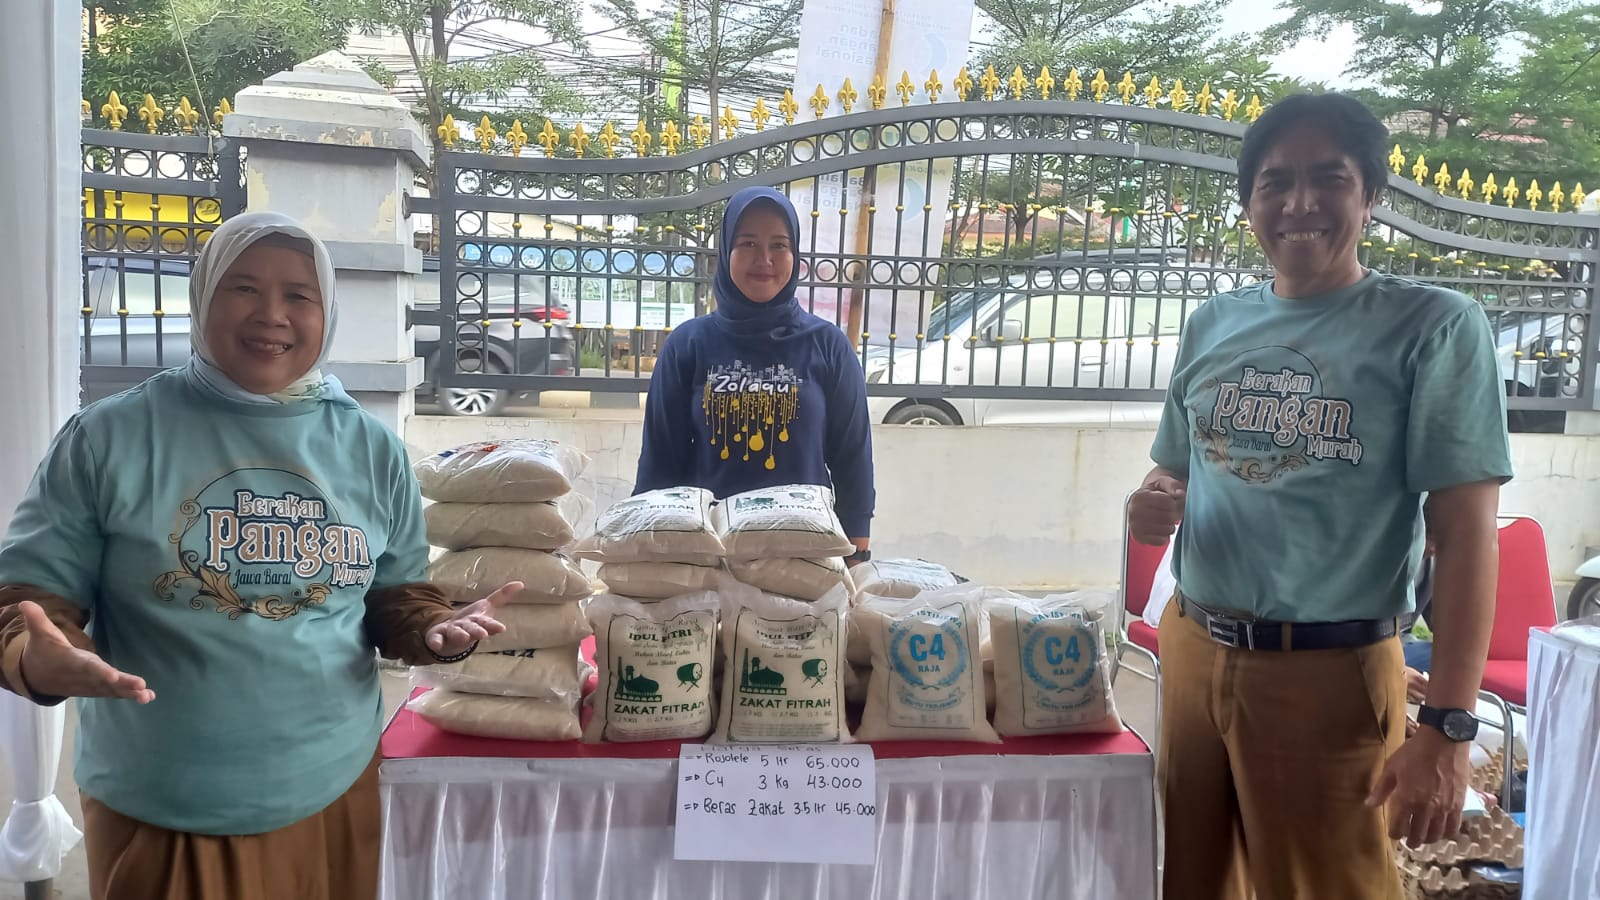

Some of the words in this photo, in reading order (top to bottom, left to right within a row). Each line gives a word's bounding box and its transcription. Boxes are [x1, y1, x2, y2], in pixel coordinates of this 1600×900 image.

[714, 375, 789, 395] Zolaqu
[1212, 382, 1351, 446] Pangan
[1307, 435, 1363, 465] Murah
[206, 509, 370, 578] Pangan
[233, 568, 261, 589] Jawa
[908, 633, 946, 662] C4
[1045, 635, 1080, 665] C4
[918, 664, 941, 673] RAJA
[614, 703, 658, 715] ZAKAT
[740, 697, 782, 709] ZAKAT
[786, 698, 831, 709] FITRAH
[760, 754, 769, 767] 5
[806, 756, 860, 769] 65.000
[758, 774, 768, 790] 3
[807, 774, 862, 790] 43.000
[704, 797, 736, 815] Beras
[748, 798, 785, 816] Zakat
[836, 802, 876, 816] 45.000
